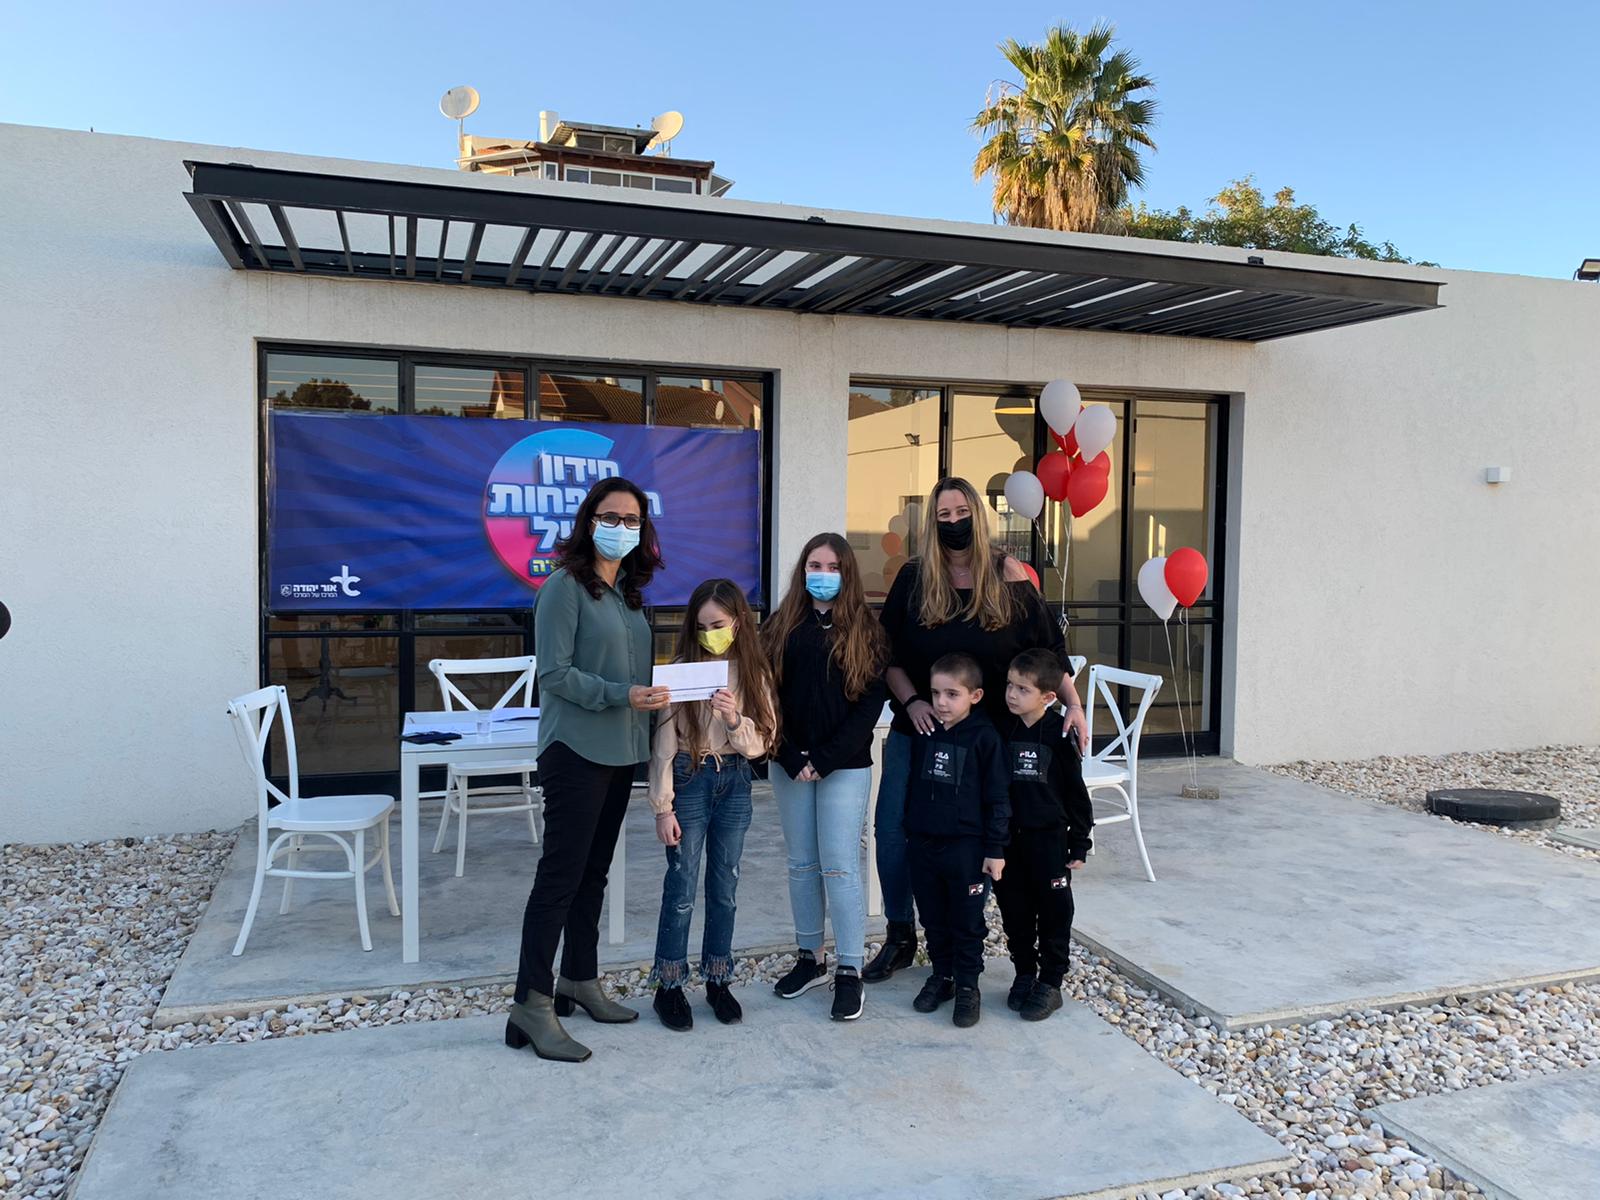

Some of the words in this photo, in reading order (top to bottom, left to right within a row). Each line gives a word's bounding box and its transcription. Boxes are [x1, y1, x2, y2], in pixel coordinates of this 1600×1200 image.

[541, 453, 619, 485] חידון
[293, 584, 319, 592] יהודה
[320, 584, 337, 592] אור
